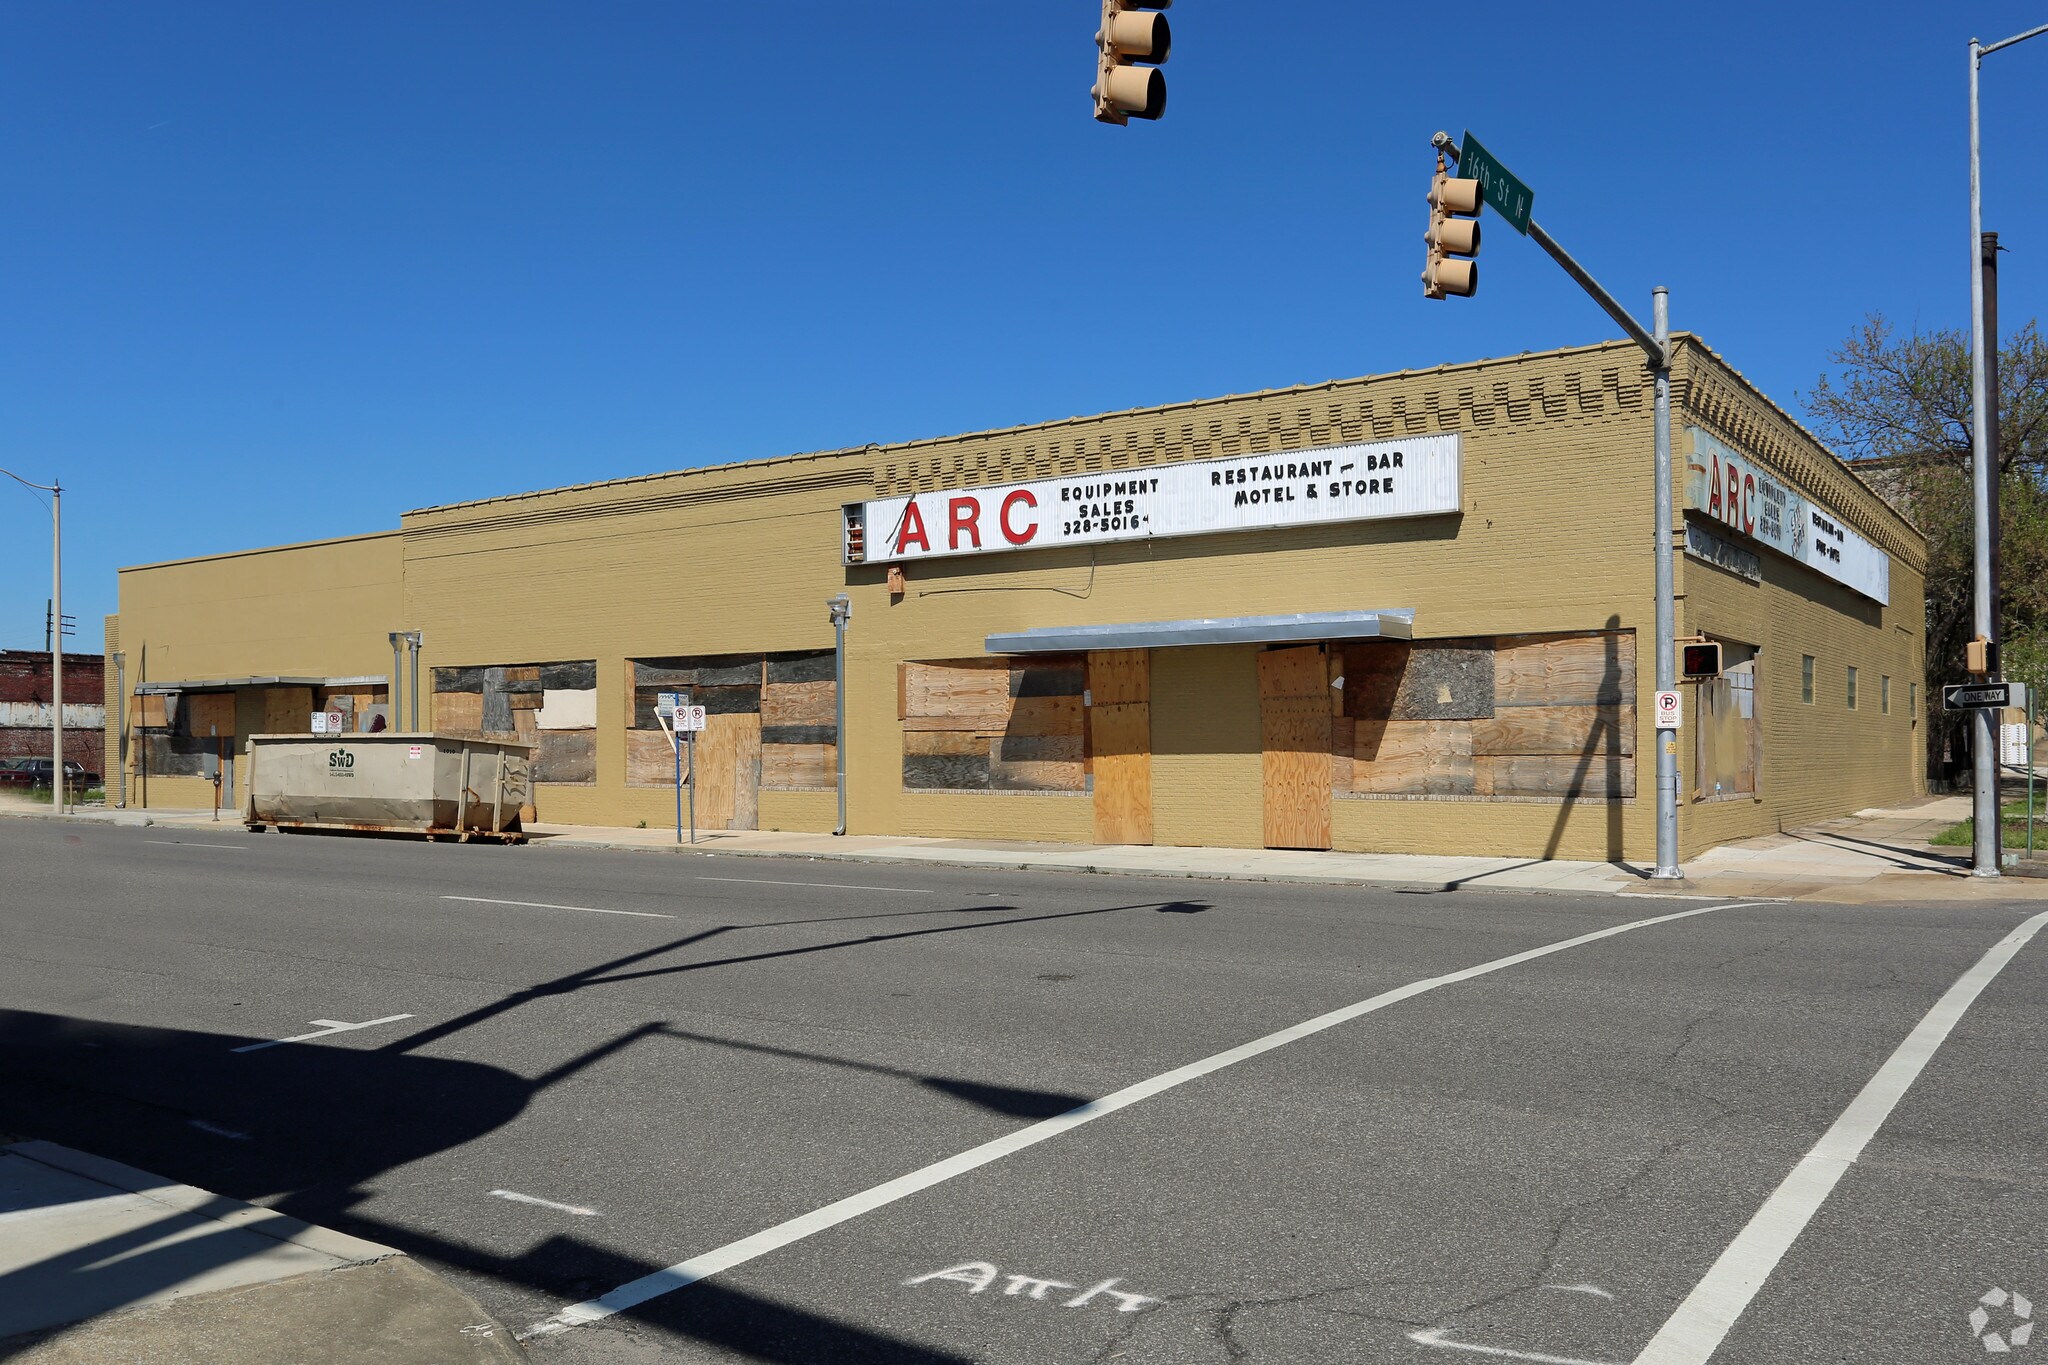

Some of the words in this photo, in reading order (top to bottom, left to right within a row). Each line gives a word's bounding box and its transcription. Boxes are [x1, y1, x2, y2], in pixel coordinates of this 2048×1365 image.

[1468, 152, 1489, 190] 16th
[1497, 177, 1510, 207] St
[1515, 193, 1524, 219] N
[1211, 460, 1333, 486] RESTAURANT
[1367, 451, 1404, 471] BAR
[1061, 478, 1159, 502] EQUIPMENT
[1234, 486, 1295, 508] MOTEL
[1306, 483, 1318, 499] &
[1329, 477, 1394, 498] STORE
[1707, 453, 1756, 537] ARC
[897, 489, 1039, 556] ARC
[1079, 499, 1134, 518] SALES
[1964, 692, 1982, 702] ONE
[1984, 690, 2001, 701] WAY
